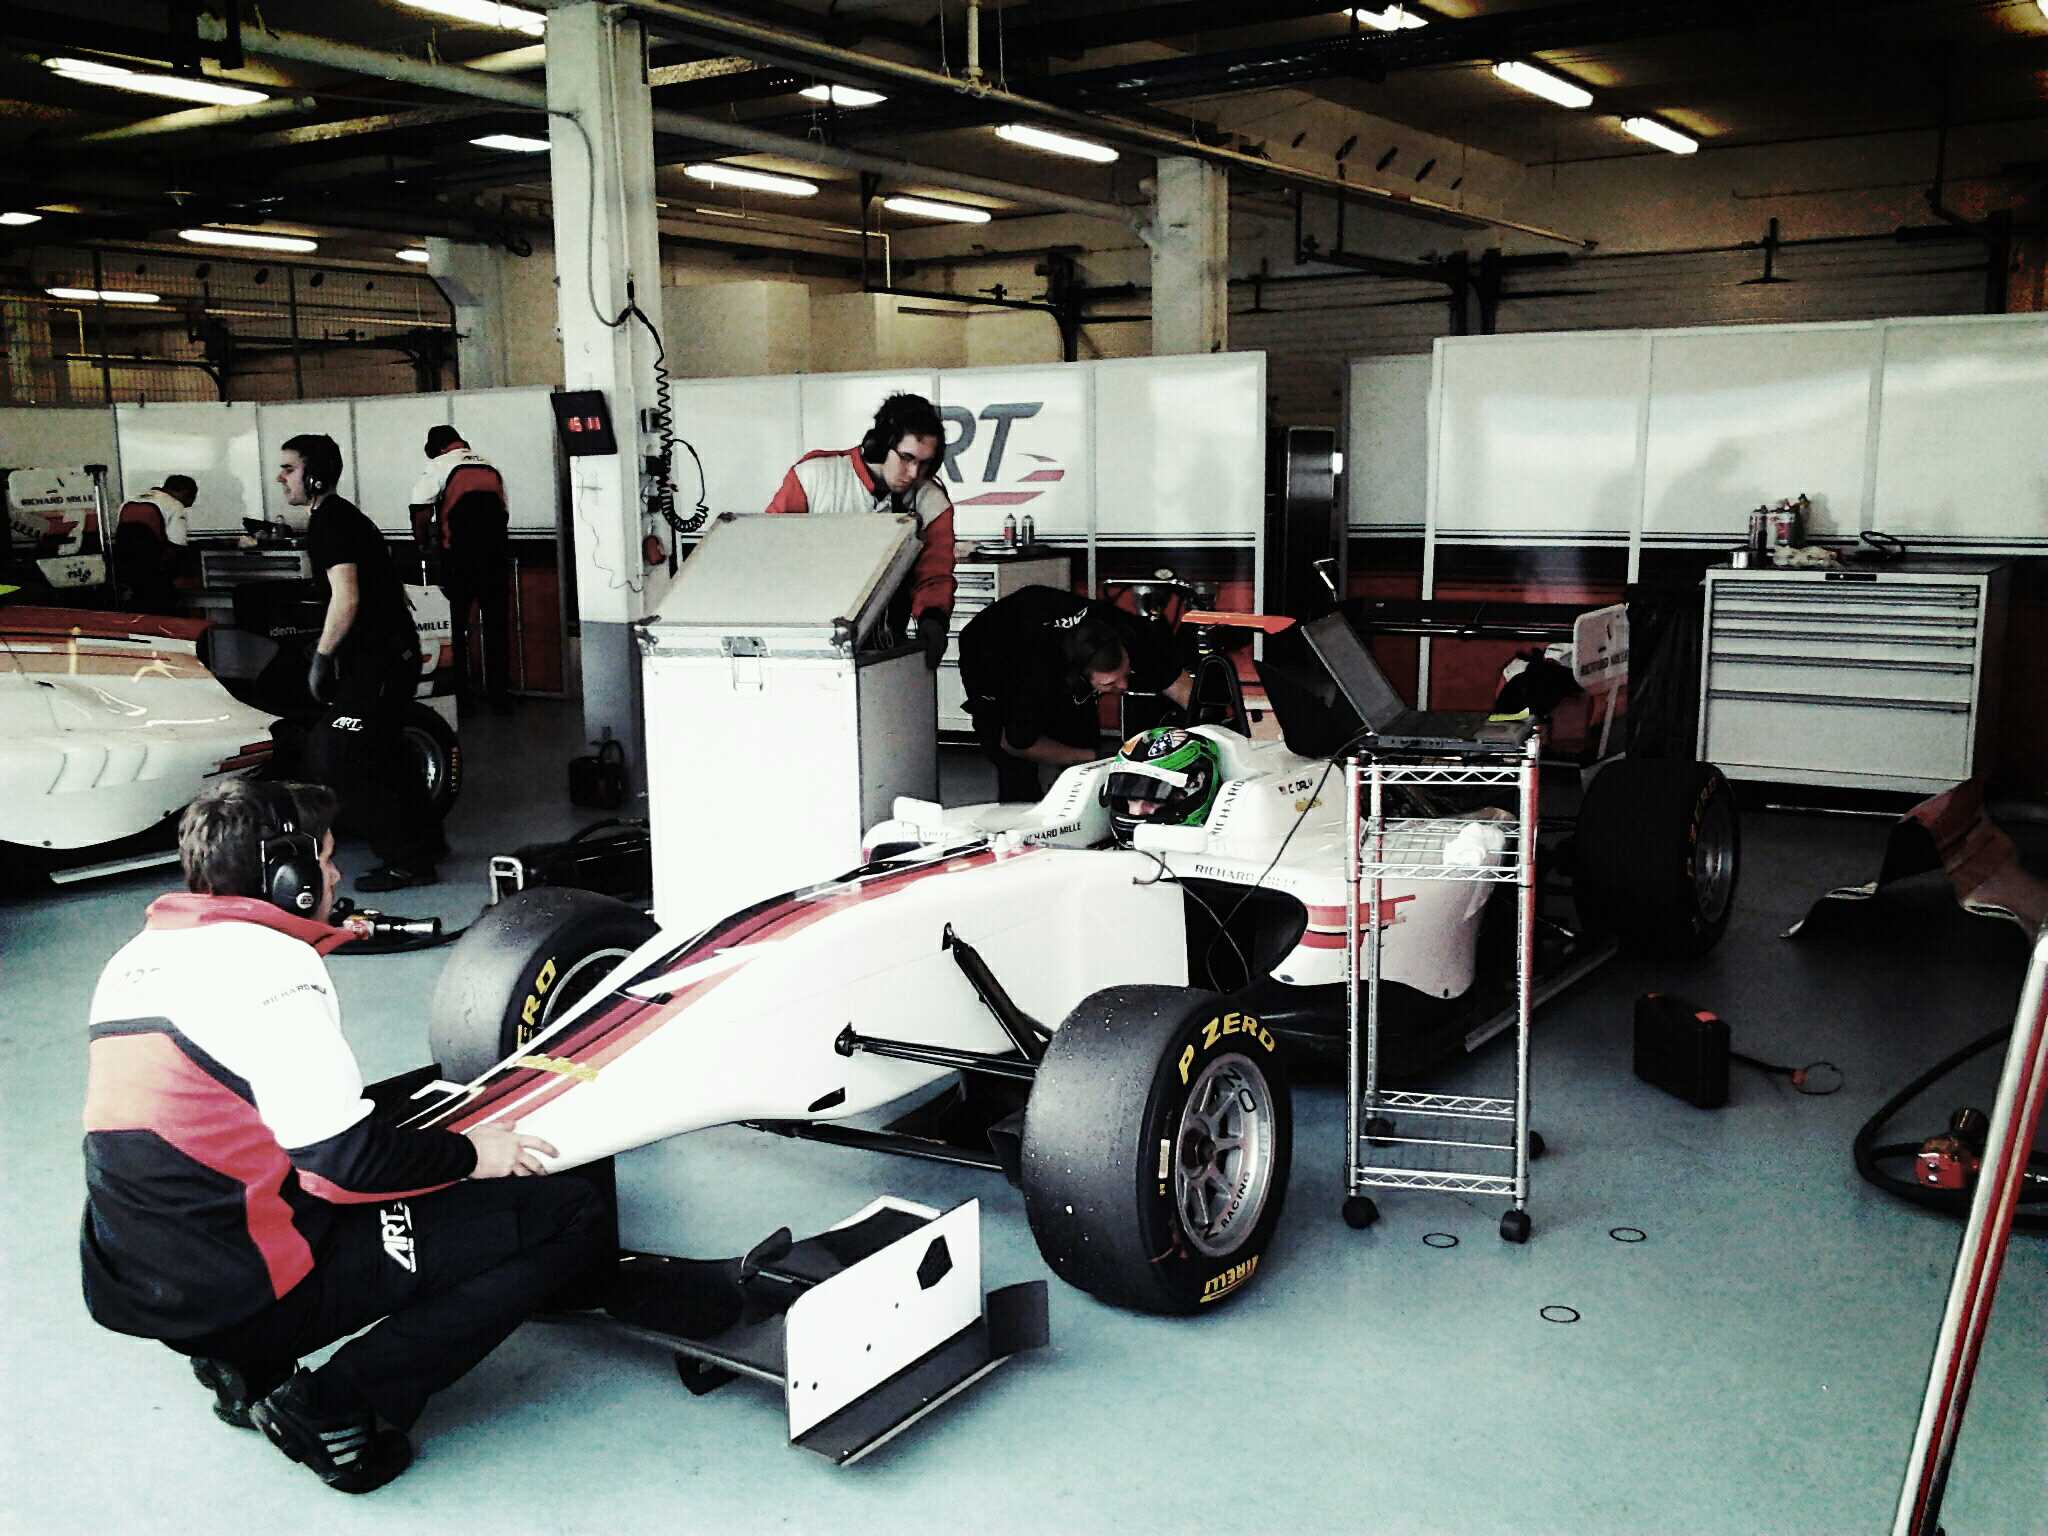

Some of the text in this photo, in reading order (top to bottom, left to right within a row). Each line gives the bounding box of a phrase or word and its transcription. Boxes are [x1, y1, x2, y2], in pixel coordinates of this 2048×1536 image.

[936, 402, 1043, 483] RT
[332, 716, 362, 730] ART
[1195, 864, 1255, 882] RICHARD
[516, 959, 557, 1051] ERO
[1178, 1012, 1276, 1085] P ZERO
[380, 1207, 416, 1273] ART
